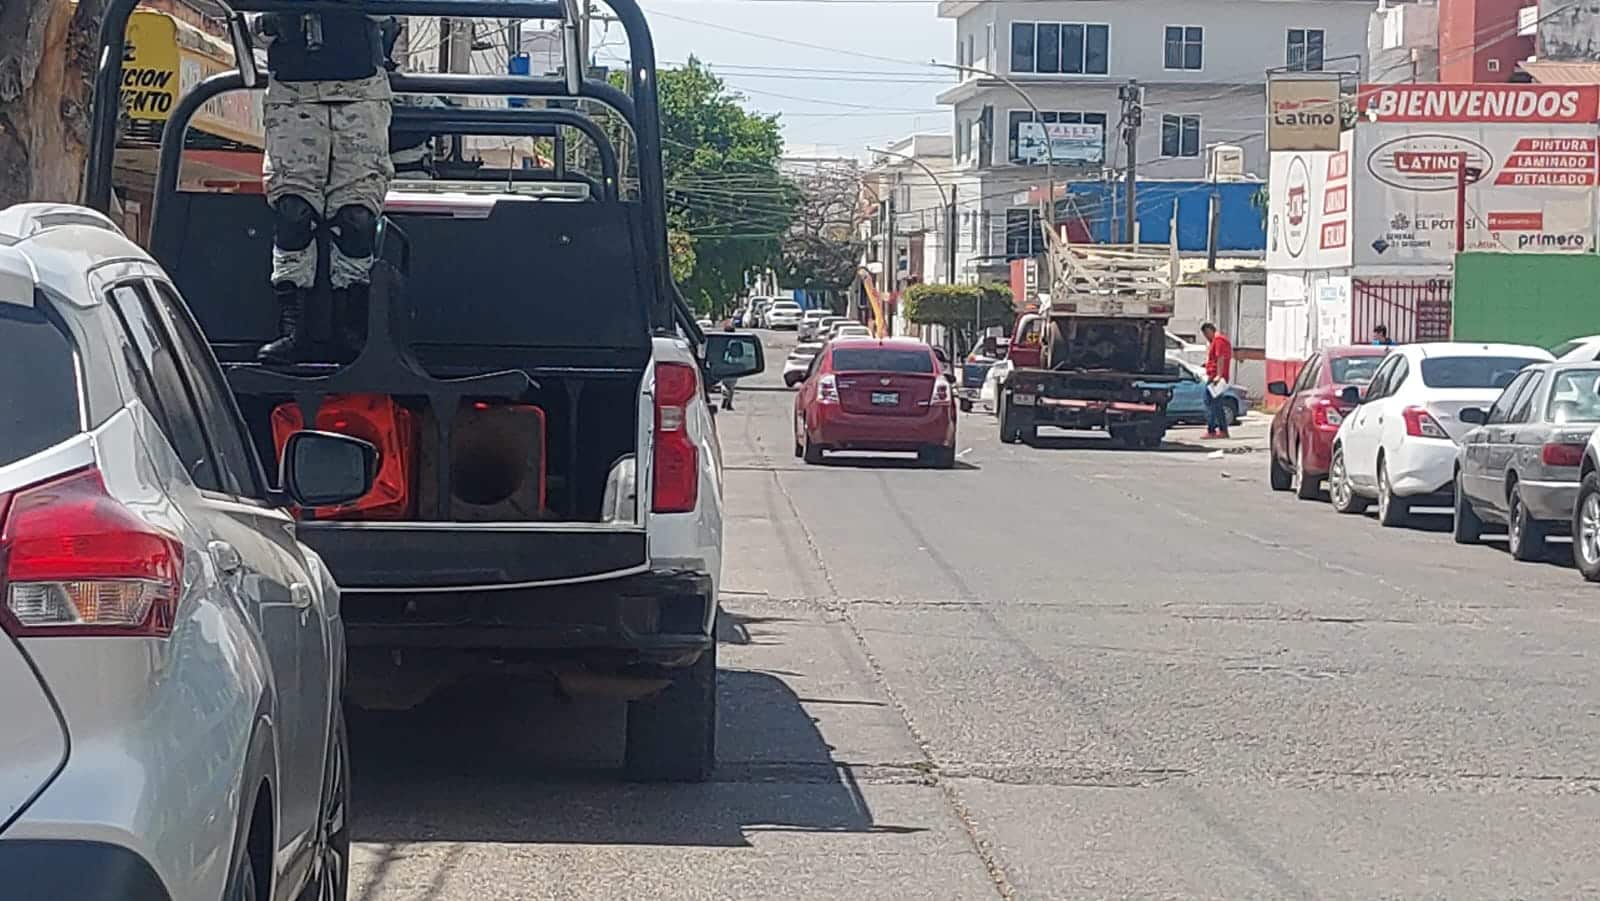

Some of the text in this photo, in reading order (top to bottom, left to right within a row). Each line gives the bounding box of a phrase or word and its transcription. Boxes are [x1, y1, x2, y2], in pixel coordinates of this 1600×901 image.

[1378, 90, 1579, 117] BIENVENIDOS
[1275, 111, 1335, 125] Latino
[1531, 139, 1588, 150] PINTURA
[1399, 155, 1460, 169] LATINO
[1517, 156, 1587, 168] LAMINADO
[1514, 173, 1587, 185] DETALLADO
[1415, 219, 1429, 230] EL
[1518, 232, 1584, 249] primero
